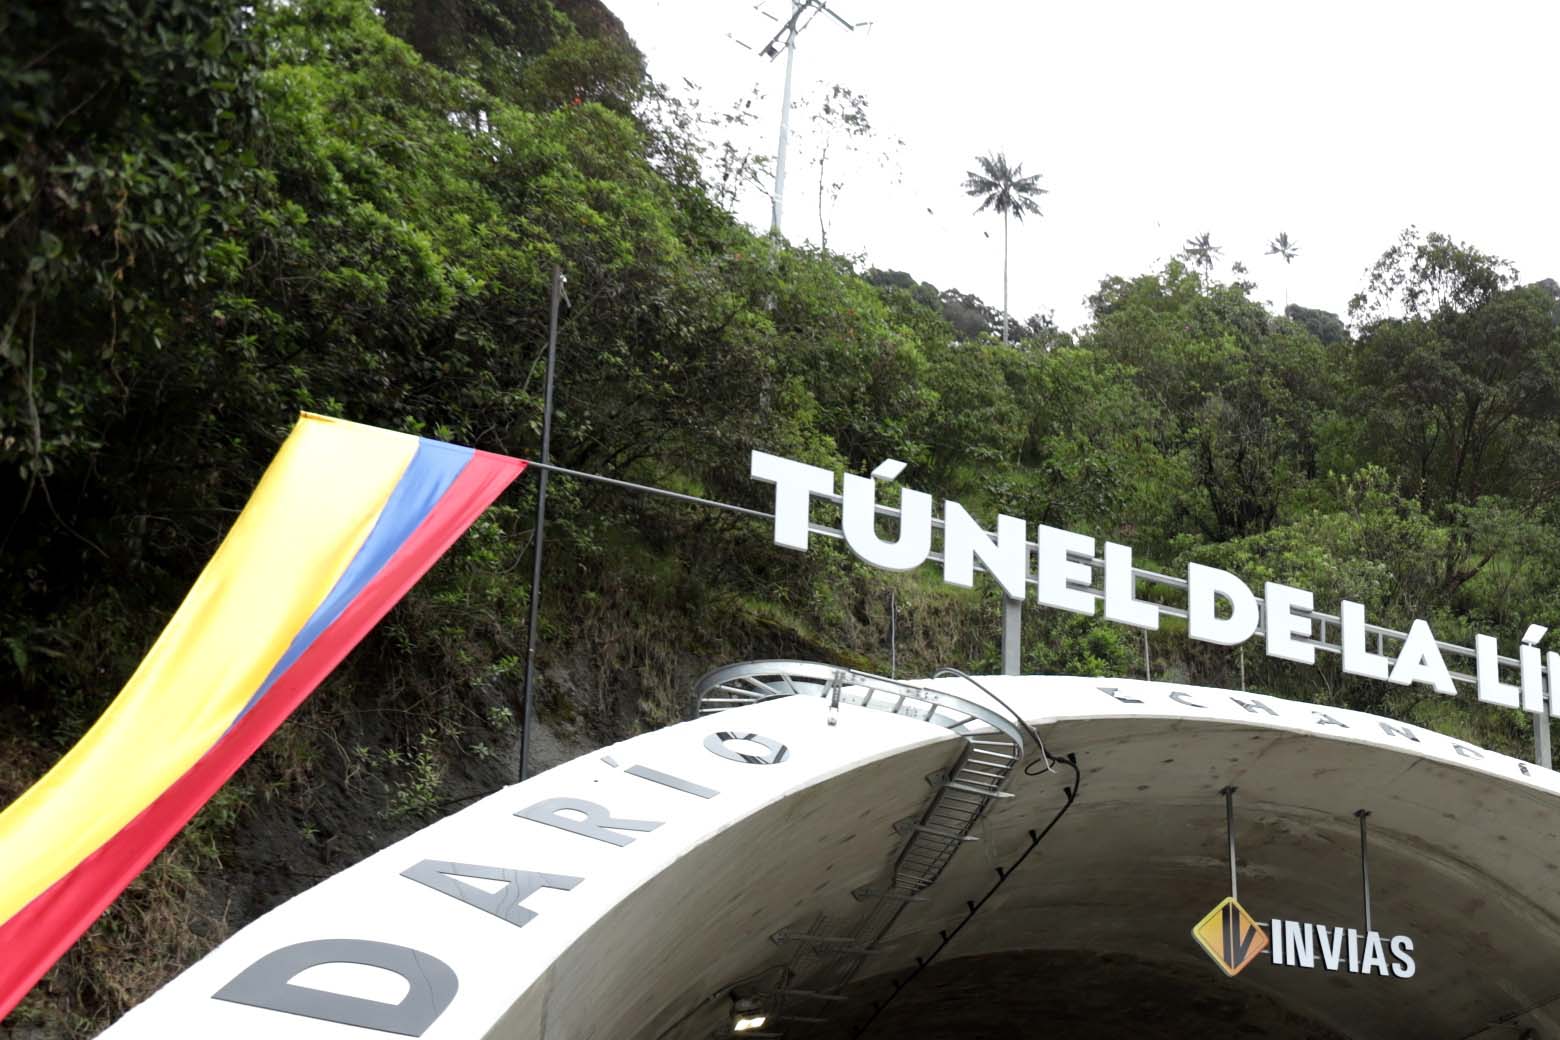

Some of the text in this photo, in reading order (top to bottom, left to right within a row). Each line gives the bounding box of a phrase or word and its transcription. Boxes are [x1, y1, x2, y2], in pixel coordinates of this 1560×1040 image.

[751, 449, 1157, 630] TÚNEL
[1188, 562, 1315, 664] DE
[1341, 600, 1458, 696] LA
[211, 731, 790, 1038] DARÍO
[1271, 918, 1416, 978] INVIAS
